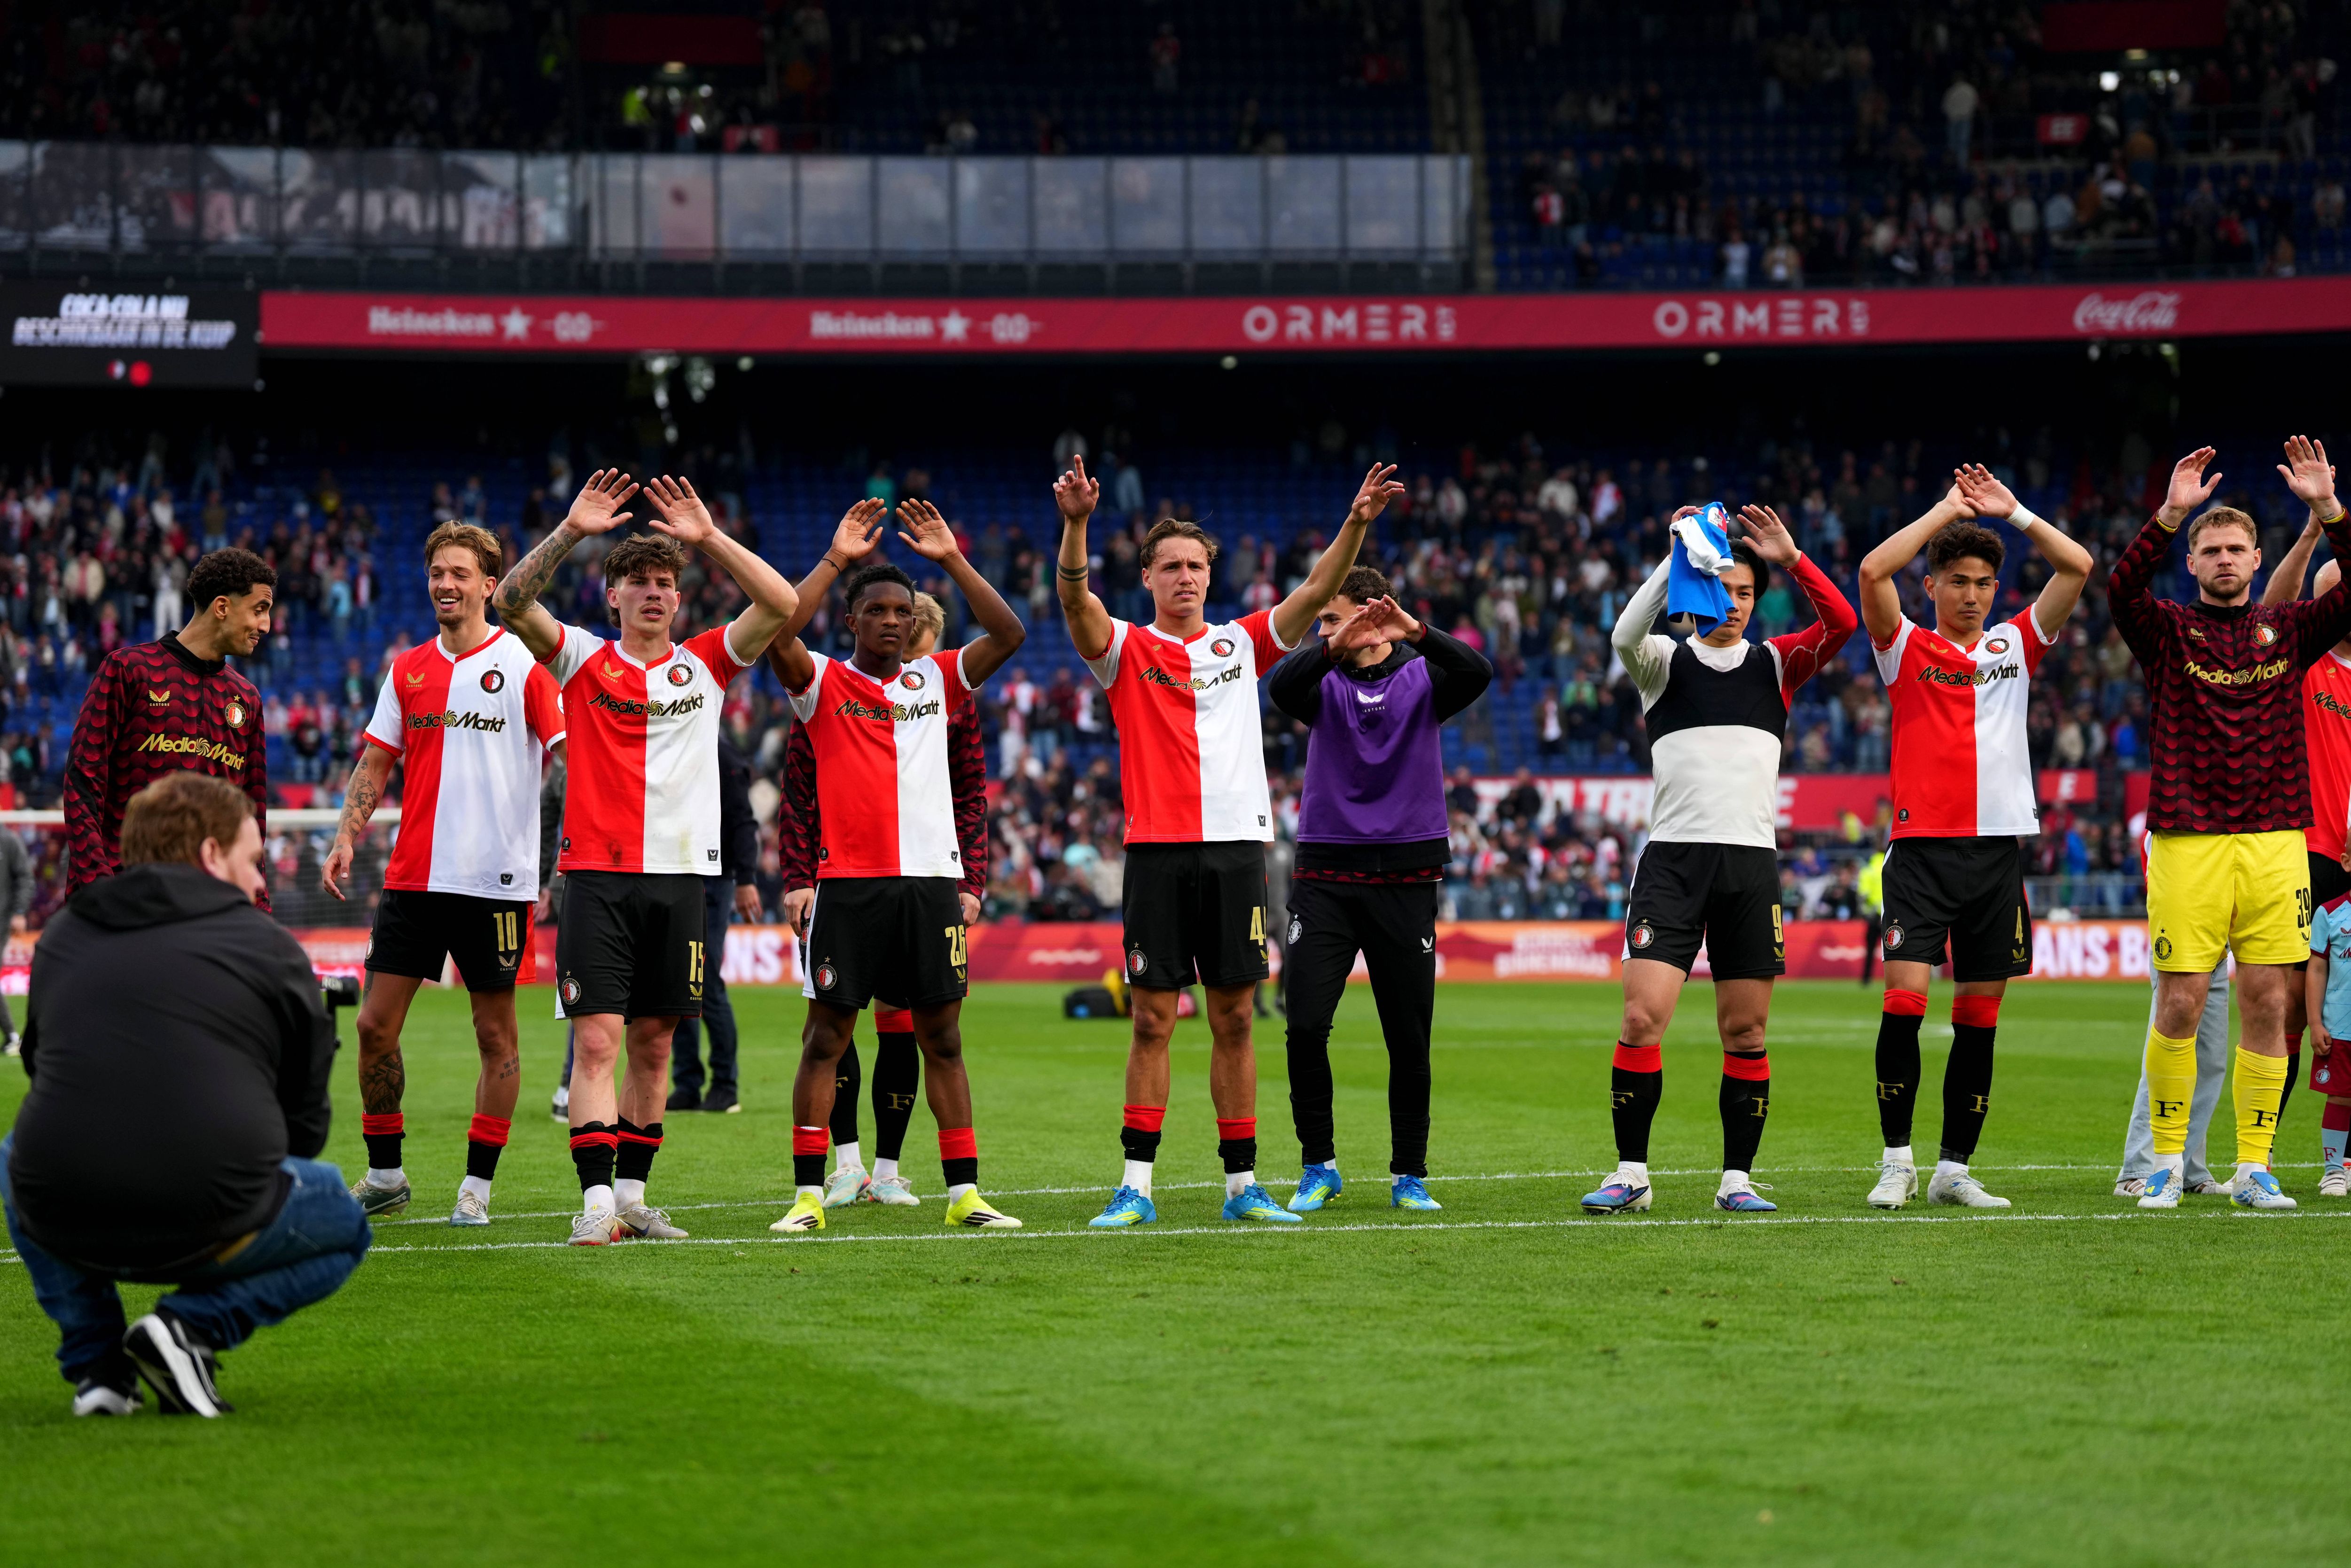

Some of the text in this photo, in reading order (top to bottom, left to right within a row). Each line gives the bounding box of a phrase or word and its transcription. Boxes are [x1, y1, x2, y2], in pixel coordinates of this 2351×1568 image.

[368, 305, 494, 336] Heineken
[810, 310, 935, 340] Heineken
[1242, 304, 1427, 342] ORMER
[1653, 298, 1840, 338] ORMER
[600, 672, 618, 683] CASTORE
[668, 664, 688, 677] FEYENOORD
[672, 673, 692, 686] ROTTERDAM
[1139, 663, 1242, 690] Media Markt
[1915, 663, 2019, 686] Media Markt
[2183, 658, 2289, 685] Media Markt
[587, 691, 704, 716] Media Markt
[834, 699, 939, 721] Media Markt
[406, 712, 506, 733] Media Markt
[137, 733, 244, 770] Media Markt
[2295, 888, 2310, 928] 39
[493, 911, 517, 952] 10
[1250, 906, 1266, 946] 4
[1634, 926, 1652, 935] FEYENOORD
[1772, 904, 1783, 943] 9
[2015, 906, 2023, 944] 4
[945, 925, 966, 967] 26
[1632, 939, 1651, 948] ROTTERDAM
[689, 941, 703, 982] 15
[887, 1092, 914, 1110] F
[1610, 1090, 1634, 1109] F
[1878, 1082, 1904, 1100] F
[2155, 1100, 2183, 1117] F
[2251, 1110, 2277, 1127] F
[2324, 1147, 2337, 1161] F
